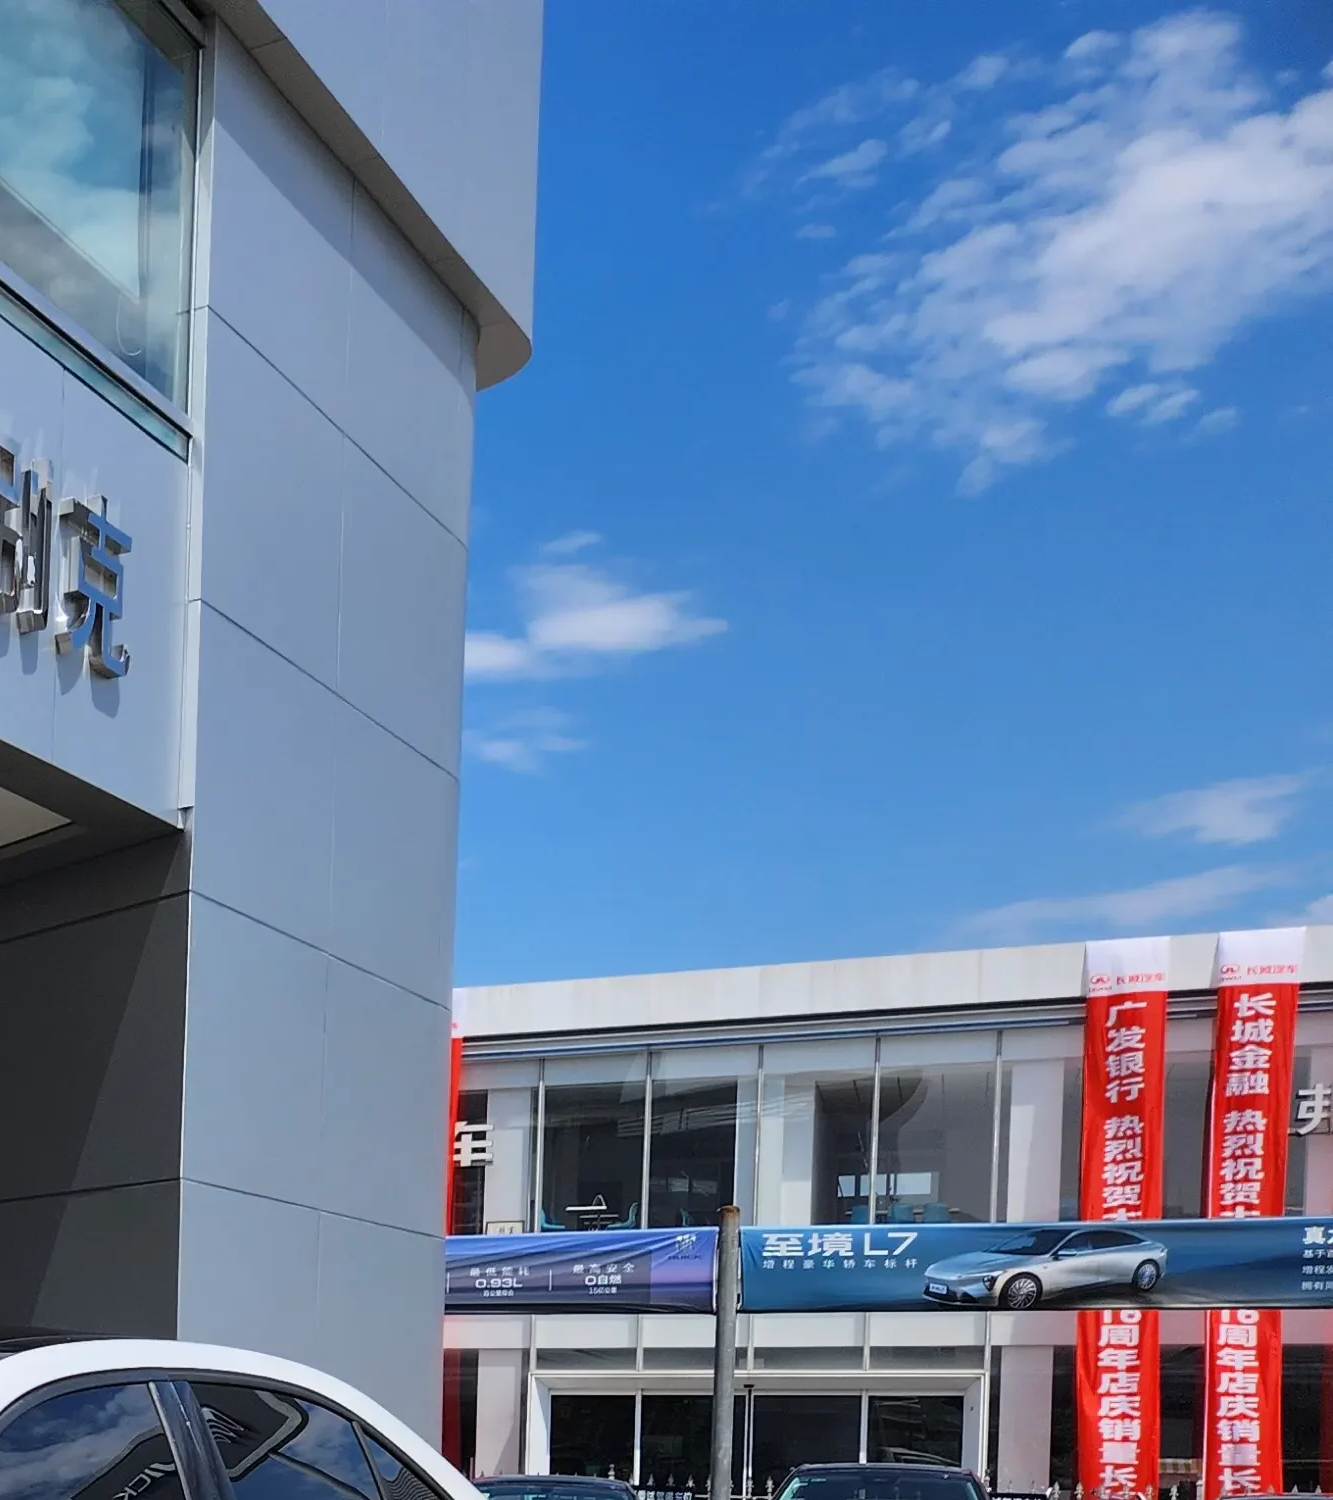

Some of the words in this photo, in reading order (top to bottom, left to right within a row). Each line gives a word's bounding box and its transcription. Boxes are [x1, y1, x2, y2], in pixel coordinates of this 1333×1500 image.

[1225, 992, 1277, 1097] 长城金融
[1105, 1000, 1148, 1103] 广发银行
[762, 1232, 854, 1257] 至境
[863, 1231, 918, 1256] L7
[573, 1263, 635, 1275] 最高安全
[762, 1258, 918, 1270] 增程豪华轿车标杆
[475, 1278, 523, 1288] 0.93L
[585, 1274, 622, 1286] 0自燃
